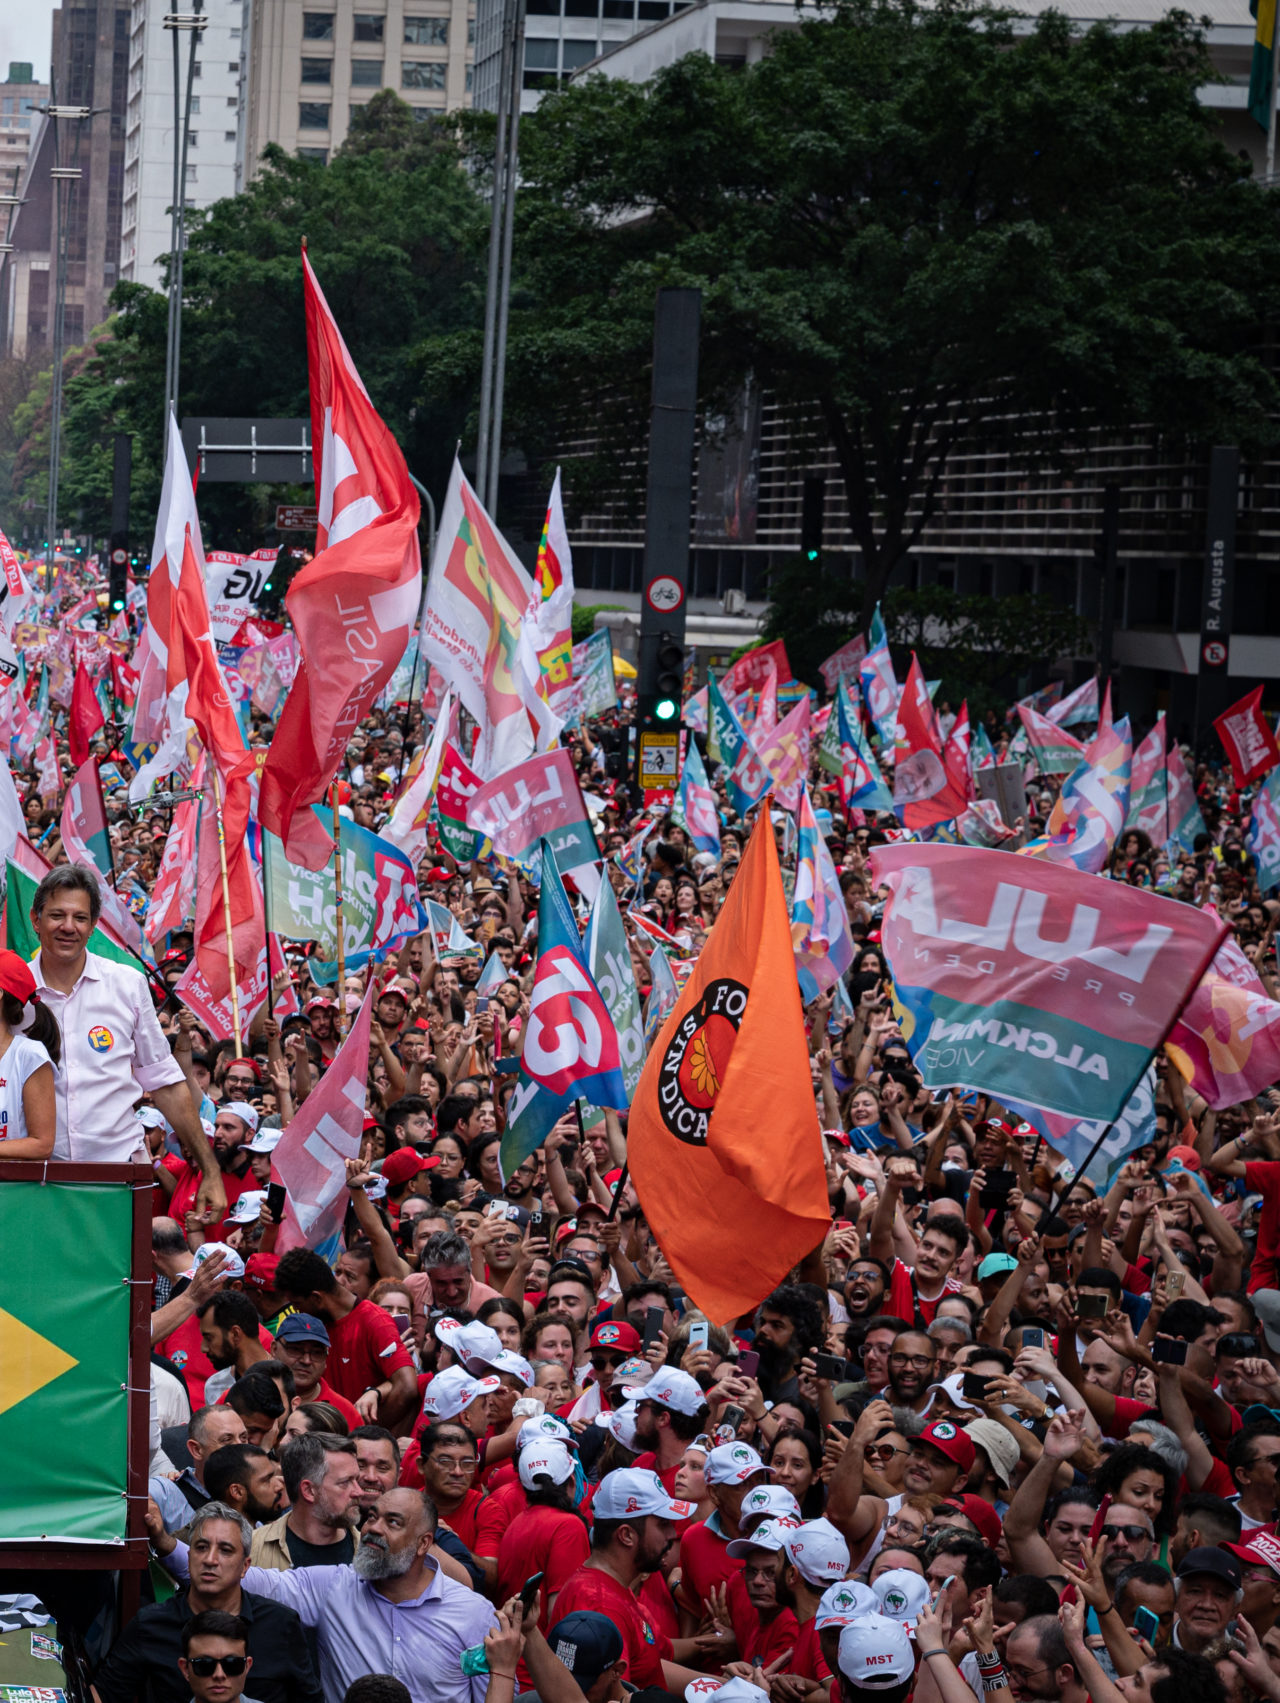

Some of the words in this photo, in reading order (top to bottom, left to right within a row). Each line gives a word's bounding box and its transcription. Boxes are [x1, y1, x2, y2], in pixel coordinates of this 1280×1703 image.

[1207, 540, 1226, 611] Augusta
[329, 881, 374, 923] Ackmin
[208, 1001, 232, 1032] Lúcia
[91, 1031, 112, 1049] 13
[527, 1459, 549, 1471] MST
[827, 1560, 845, 1573] MST
[865, 1653, 894, 1667] MST
[6, 1688, 31, 1698] Lula
[31, 1687, 54, 1700] 13
